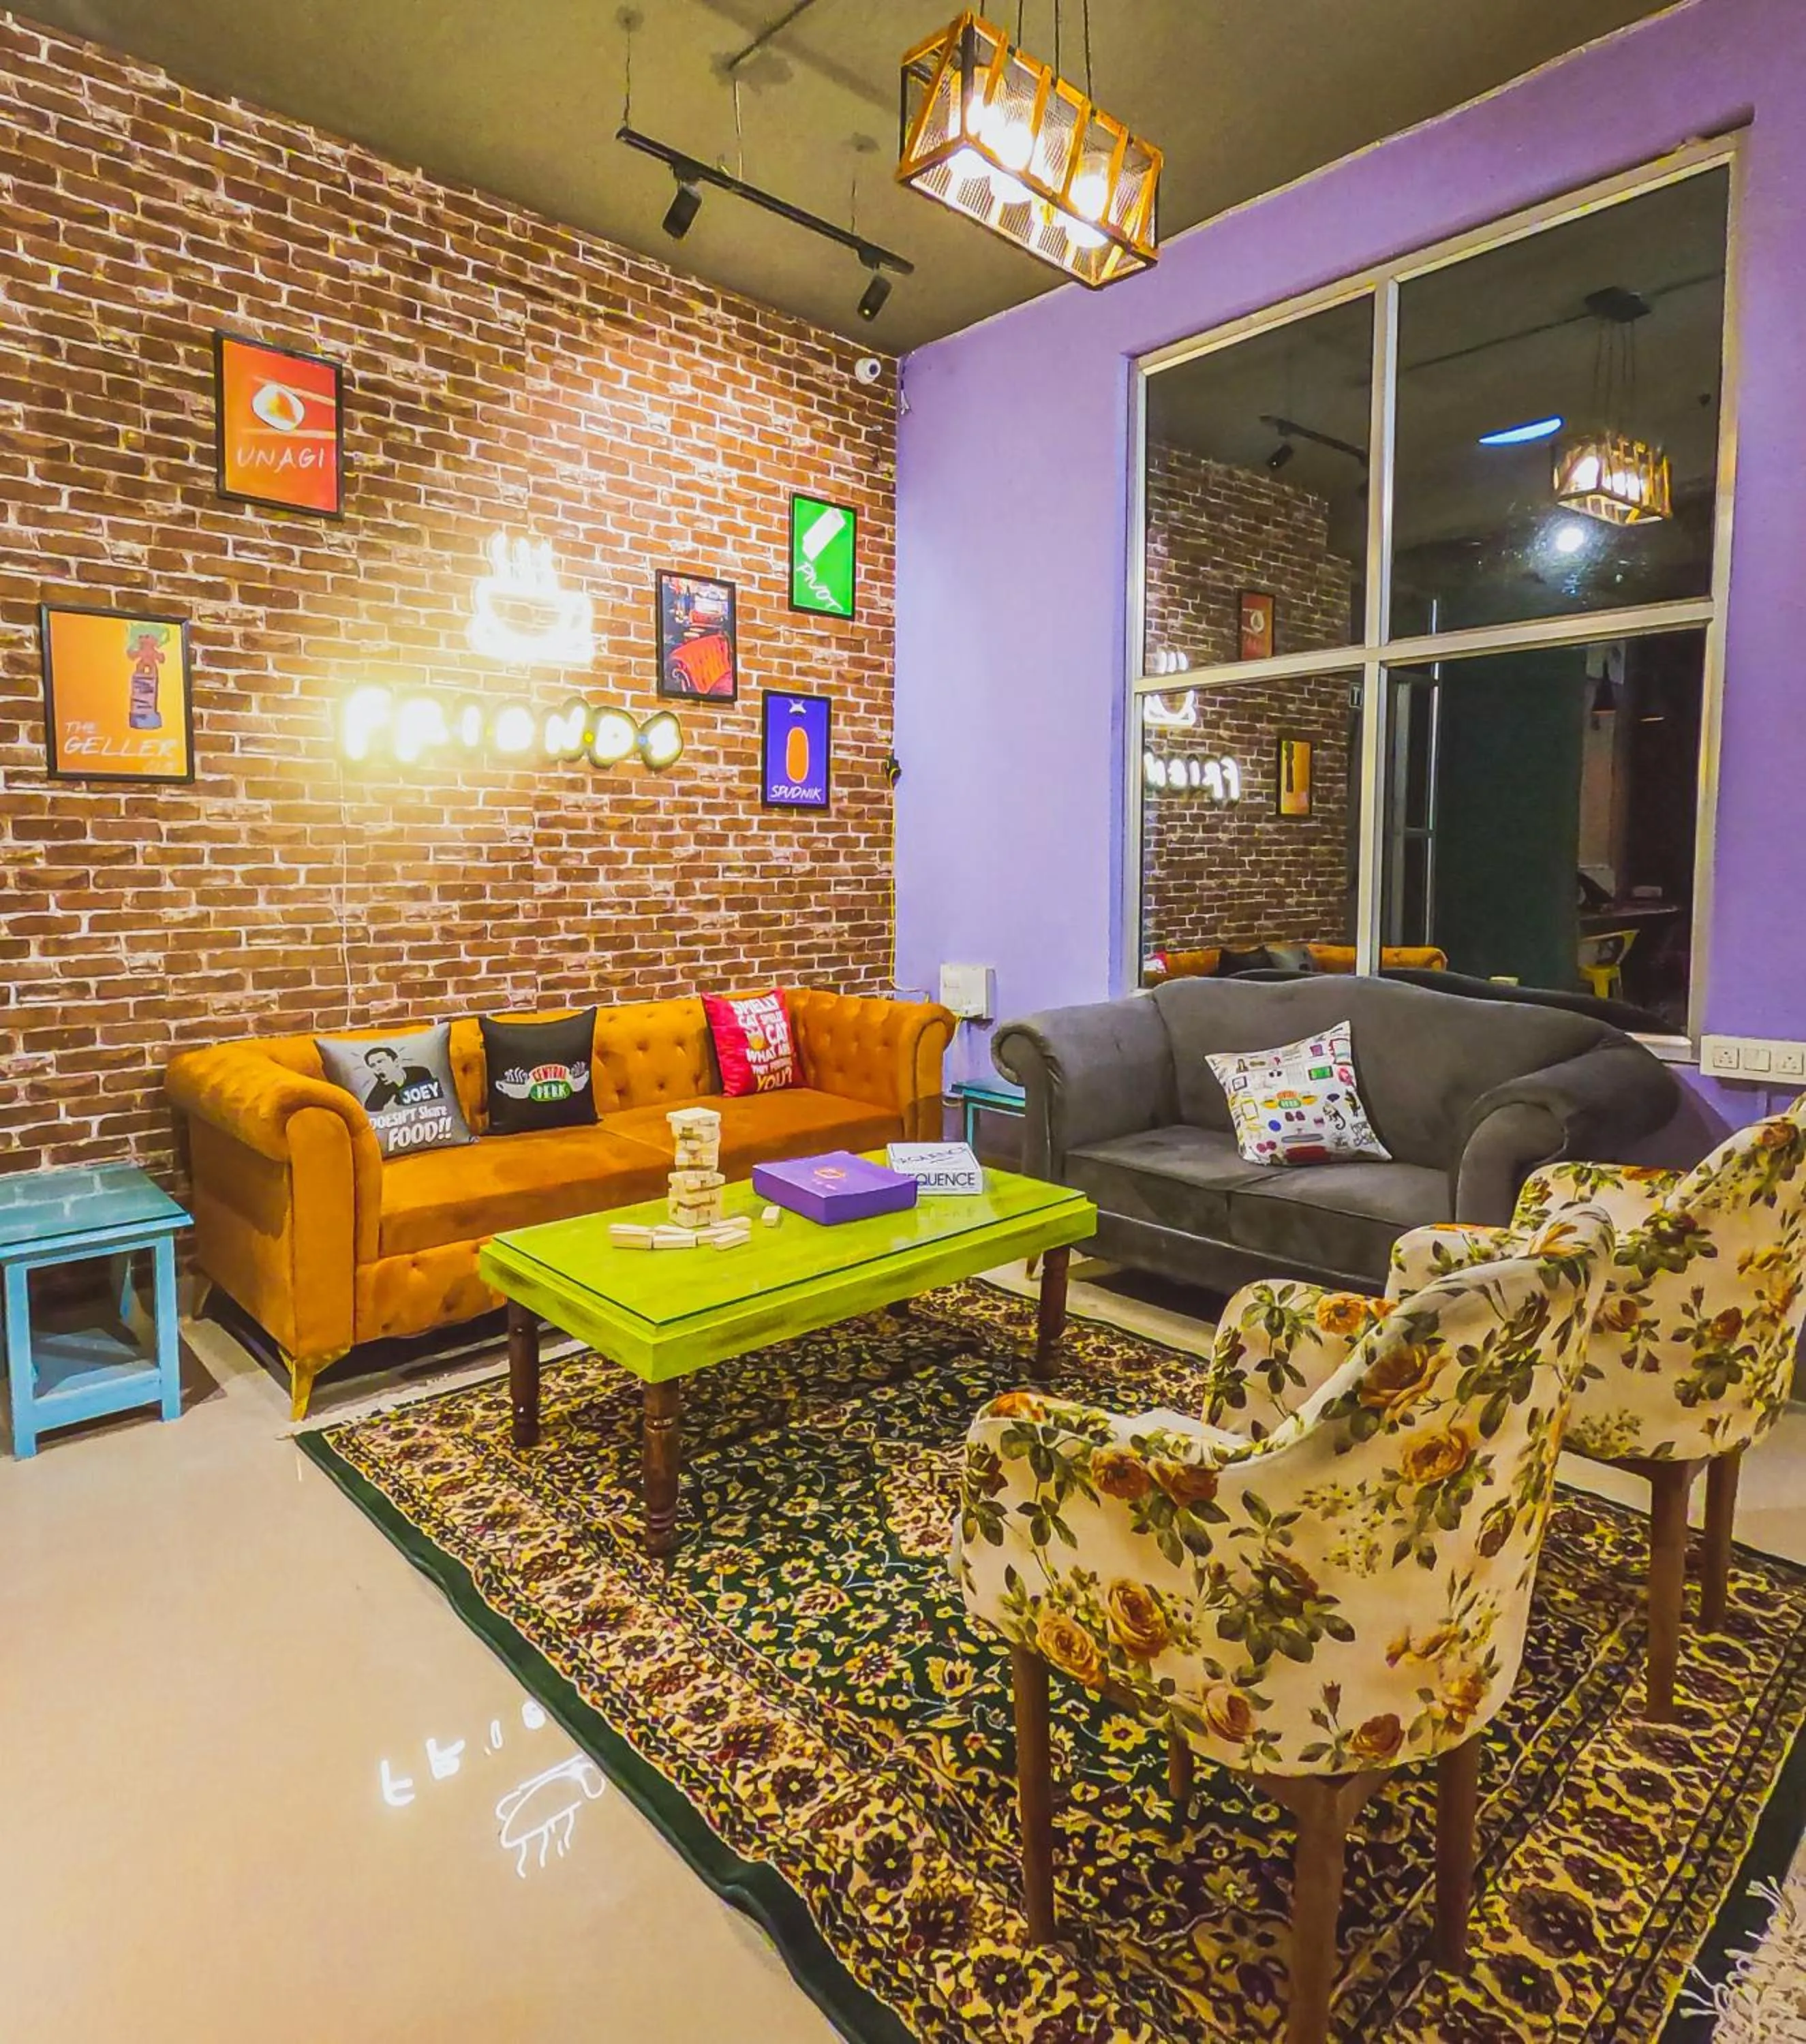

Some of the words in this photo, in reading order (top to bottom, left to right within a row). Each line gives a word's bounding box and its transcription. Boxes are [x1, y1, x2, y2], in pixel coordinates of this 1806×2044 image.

[238, 446, 325, 474] UNAGI
[795, 561, 844, 611] PIVOT
[63, 736, 177, 757] GELLER
[770, 784, 823, 802] SPUDNIK
[756, 1066, 793, 1092] YOU?
[402, 1081, 438, 1104] JOEY
[388, 1116, 452, 1152] FOOD!!
[907, 1172, 975, 1186] QUENCE
